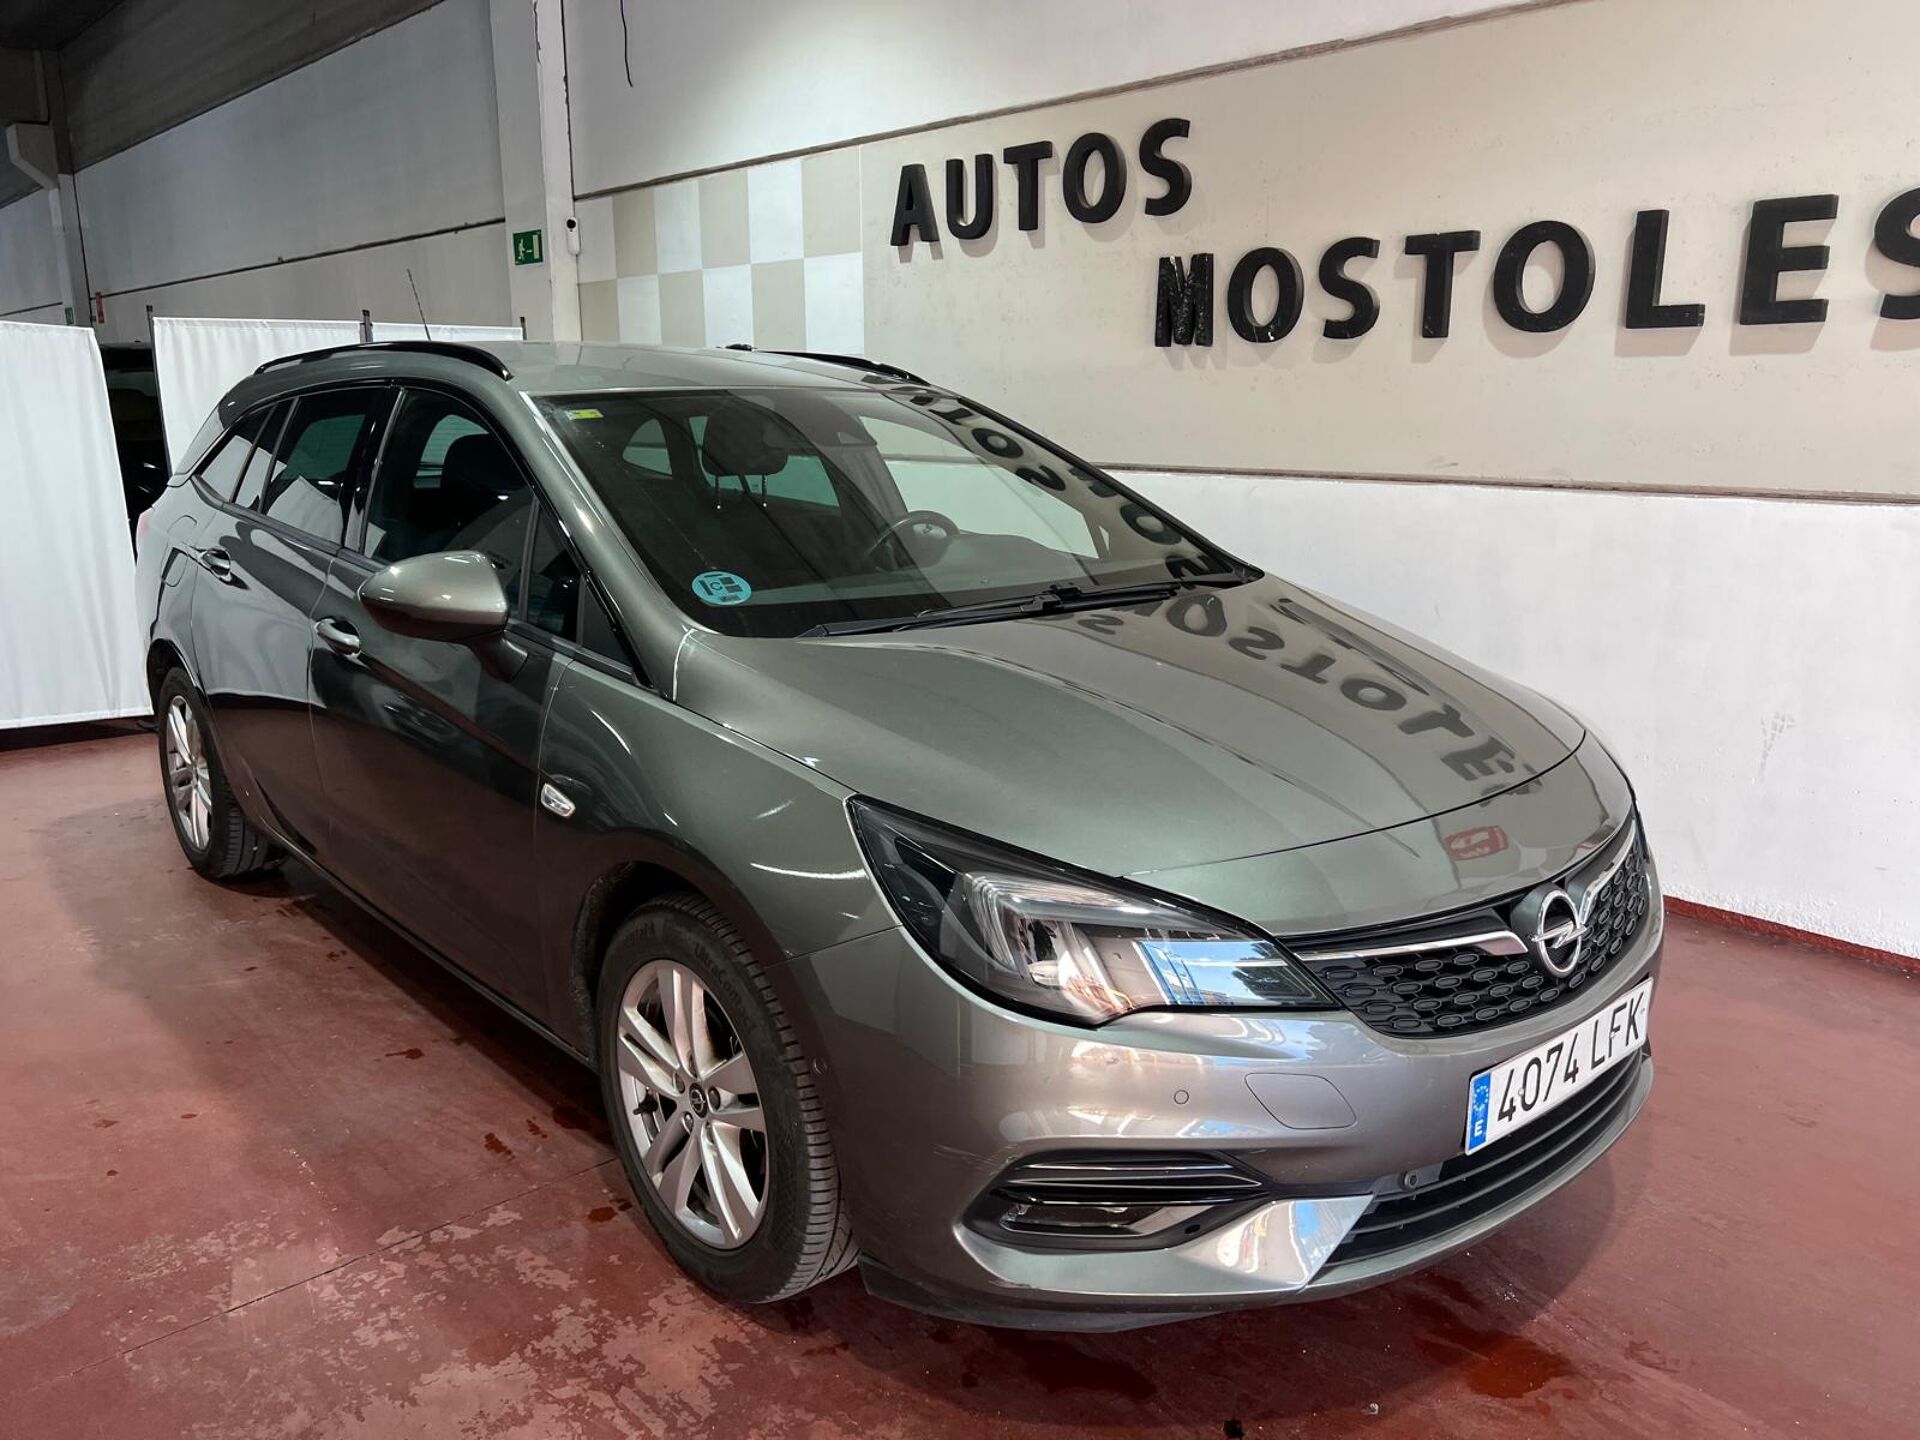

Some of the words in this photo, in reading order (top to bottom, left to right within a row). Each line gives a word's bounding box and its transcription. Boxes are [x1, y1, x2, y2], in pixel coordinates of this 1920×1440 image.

[890, 118, 1192, 246] AUTOS
[1155, 186, 1920, 347] MOSTOLES
[1497, 1032, 1579, 1122] 4074
[1590, 991, 1645, 1070] LFK
[1474, 1119, 1483, 1136] E
